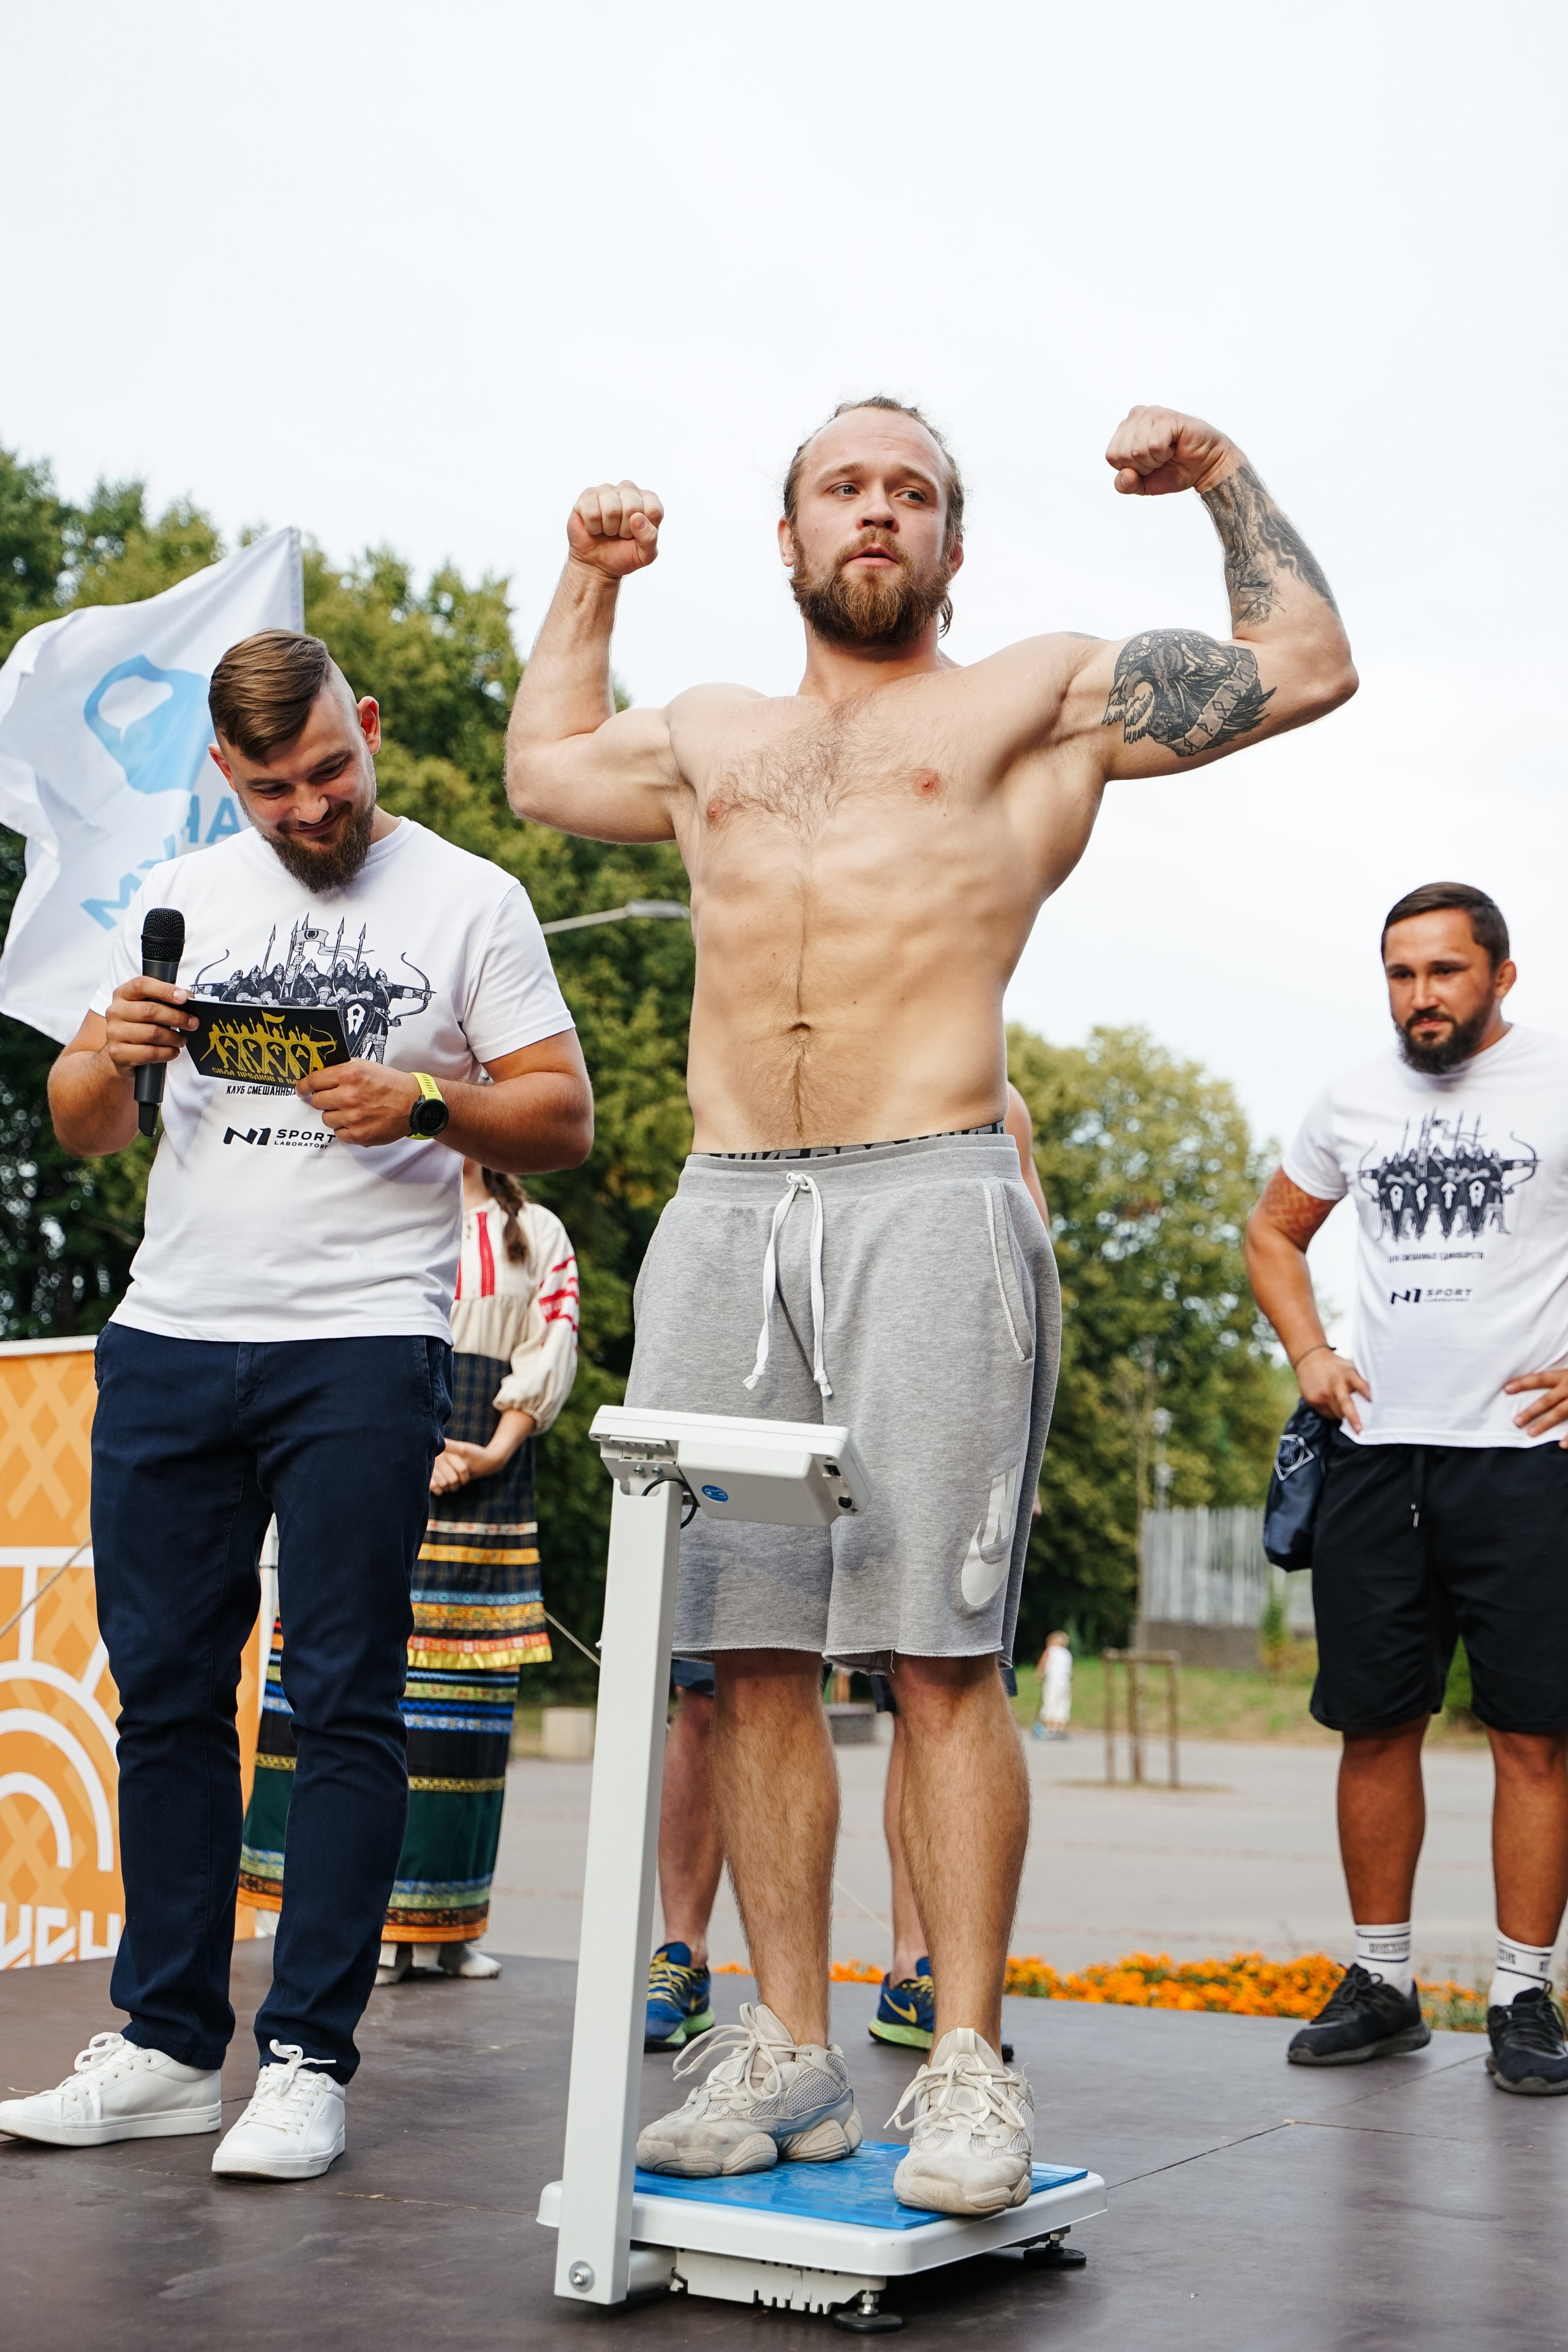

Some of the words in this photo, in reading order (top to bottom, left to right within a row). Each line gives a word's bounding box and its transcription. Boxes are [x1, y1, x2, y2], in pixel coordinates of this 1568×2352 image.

[226, 1085, 246, 1095] КЛУБ
[276, 1129, 336, 1144] SPORT
[274, 1140, 329, 1150] LABORATORY
